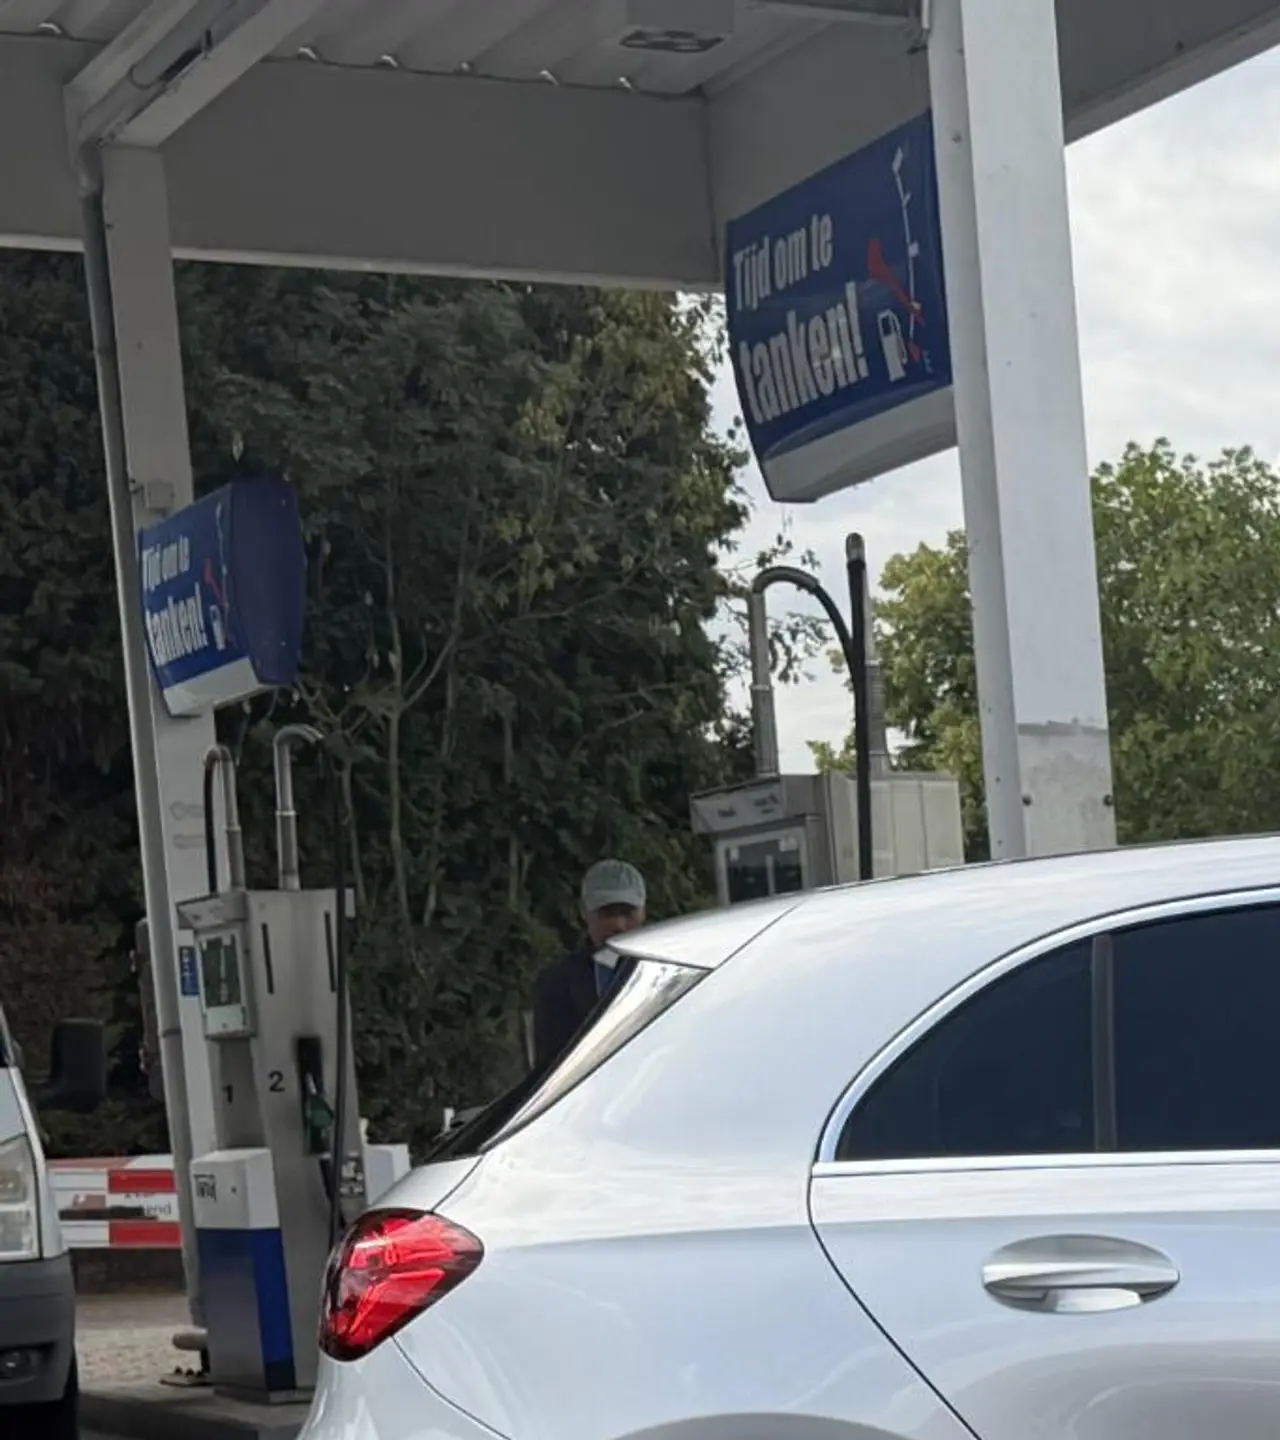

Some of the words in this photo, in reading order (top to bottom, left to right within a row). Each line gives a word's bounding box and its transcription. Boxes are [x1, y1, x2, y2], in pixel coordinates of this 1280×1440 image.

[733, 236, 771, 311] Tijd
[774, 228, 808, 290] om
[811, 213, 833, 271] te
[739, 281, 869, 424] tanken!
[222, 1084, 233, 1104] 1
[268, 1070, 285, 1092] 2
